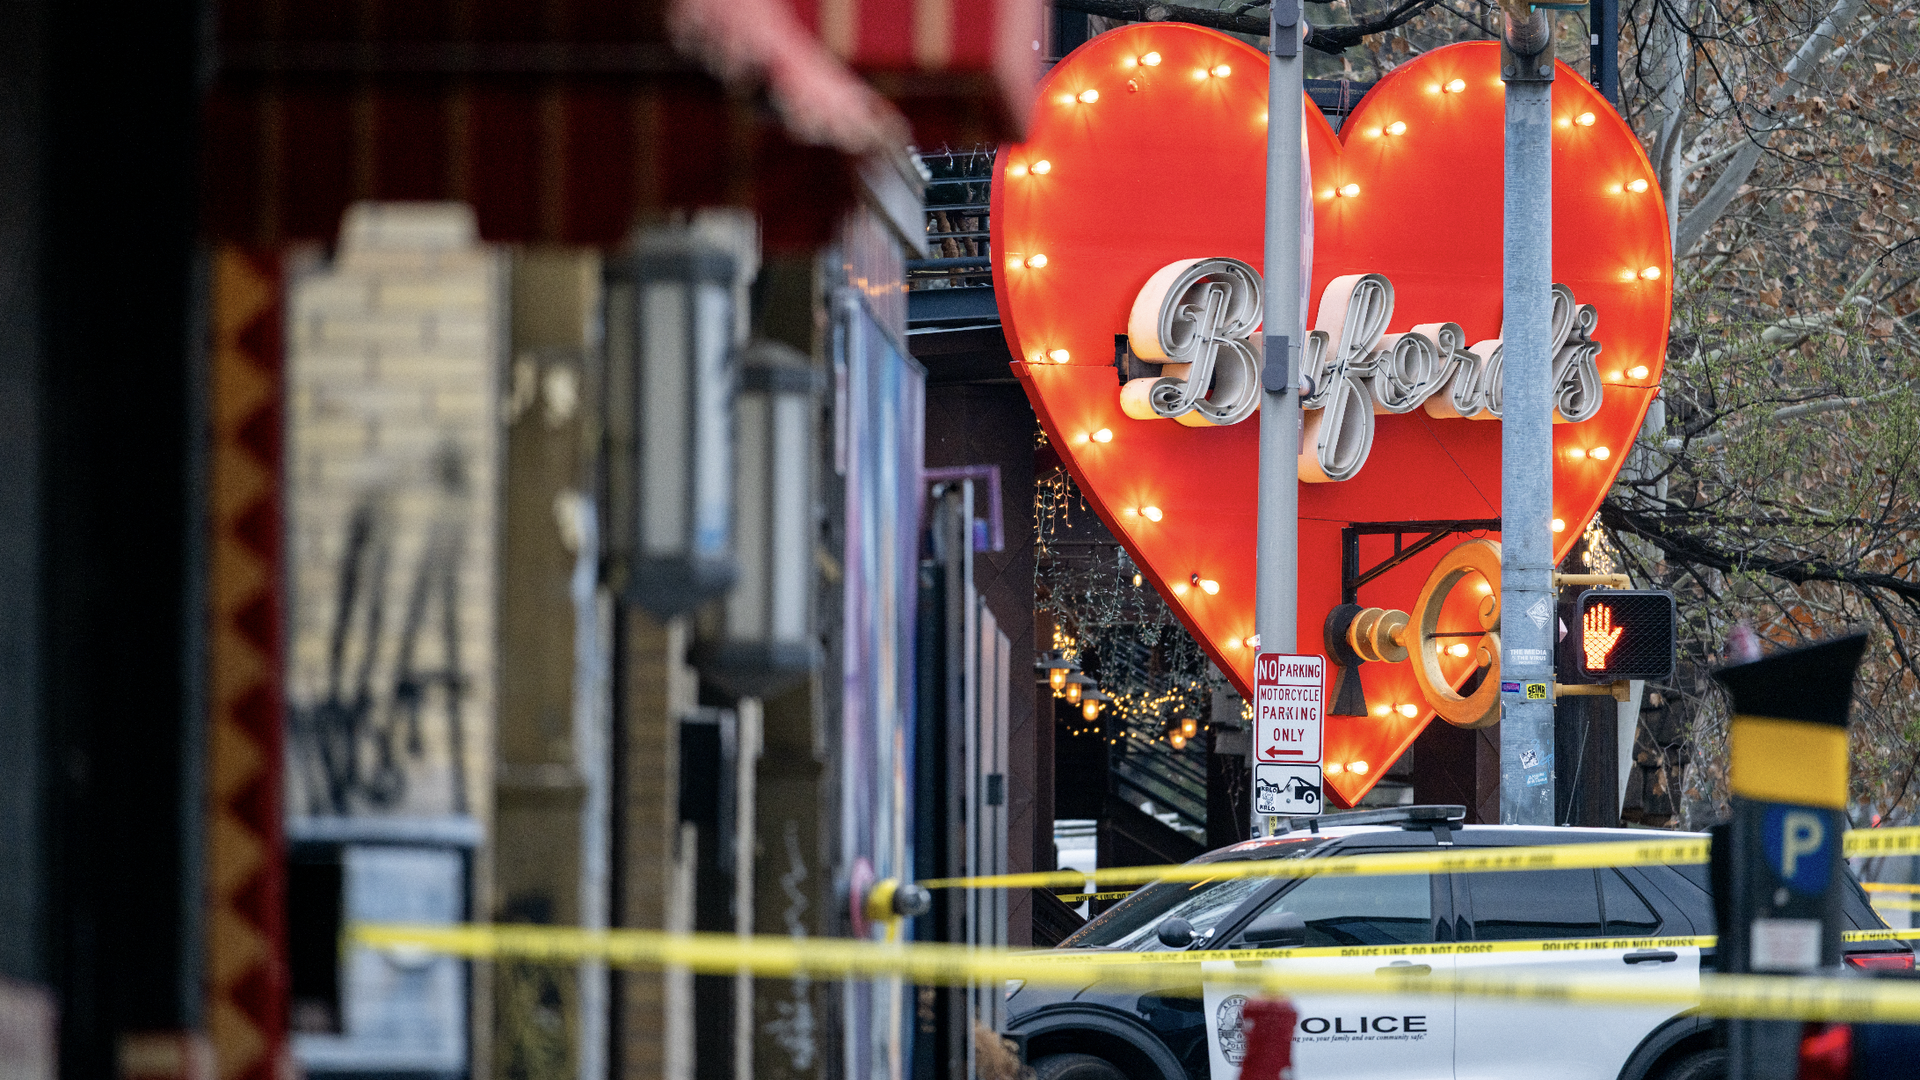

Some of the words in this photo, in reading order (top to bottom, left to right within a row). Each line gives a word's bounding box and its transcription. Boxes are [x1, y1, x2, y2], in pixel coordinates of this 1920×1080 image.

[1259, 660, 1277, 680] NO
[1280, 663, 1320, 678] PARKING
[1260, 688, 1319, 701] MOTORCYCLE
[1262, 706, 1316, 720] PARKING
[1273, 728, 1304, 742] ONLY
[1782, 808, 1825, 880] P
[1341, 948, 1379, 957] POLICE
[1383, 947, 1407, 956] LINE
[1412, 946, 1427, 955] DO
[1431, 946, 1451, 954] NOT
[1456, 945, 1493, 953] CROSS
[1542, 942, 1580, 950] POLICE
[1584, 942, 1608, 950] LINE
[1613, 941, 1628, 949] DO
[1633, 940, 1653, 948] NOT
[1658, 939, 1695, 947] CROSS
[1300, 1016, 1428, 1034] OLICE
[1331, 1034, 1350, 1042] family
